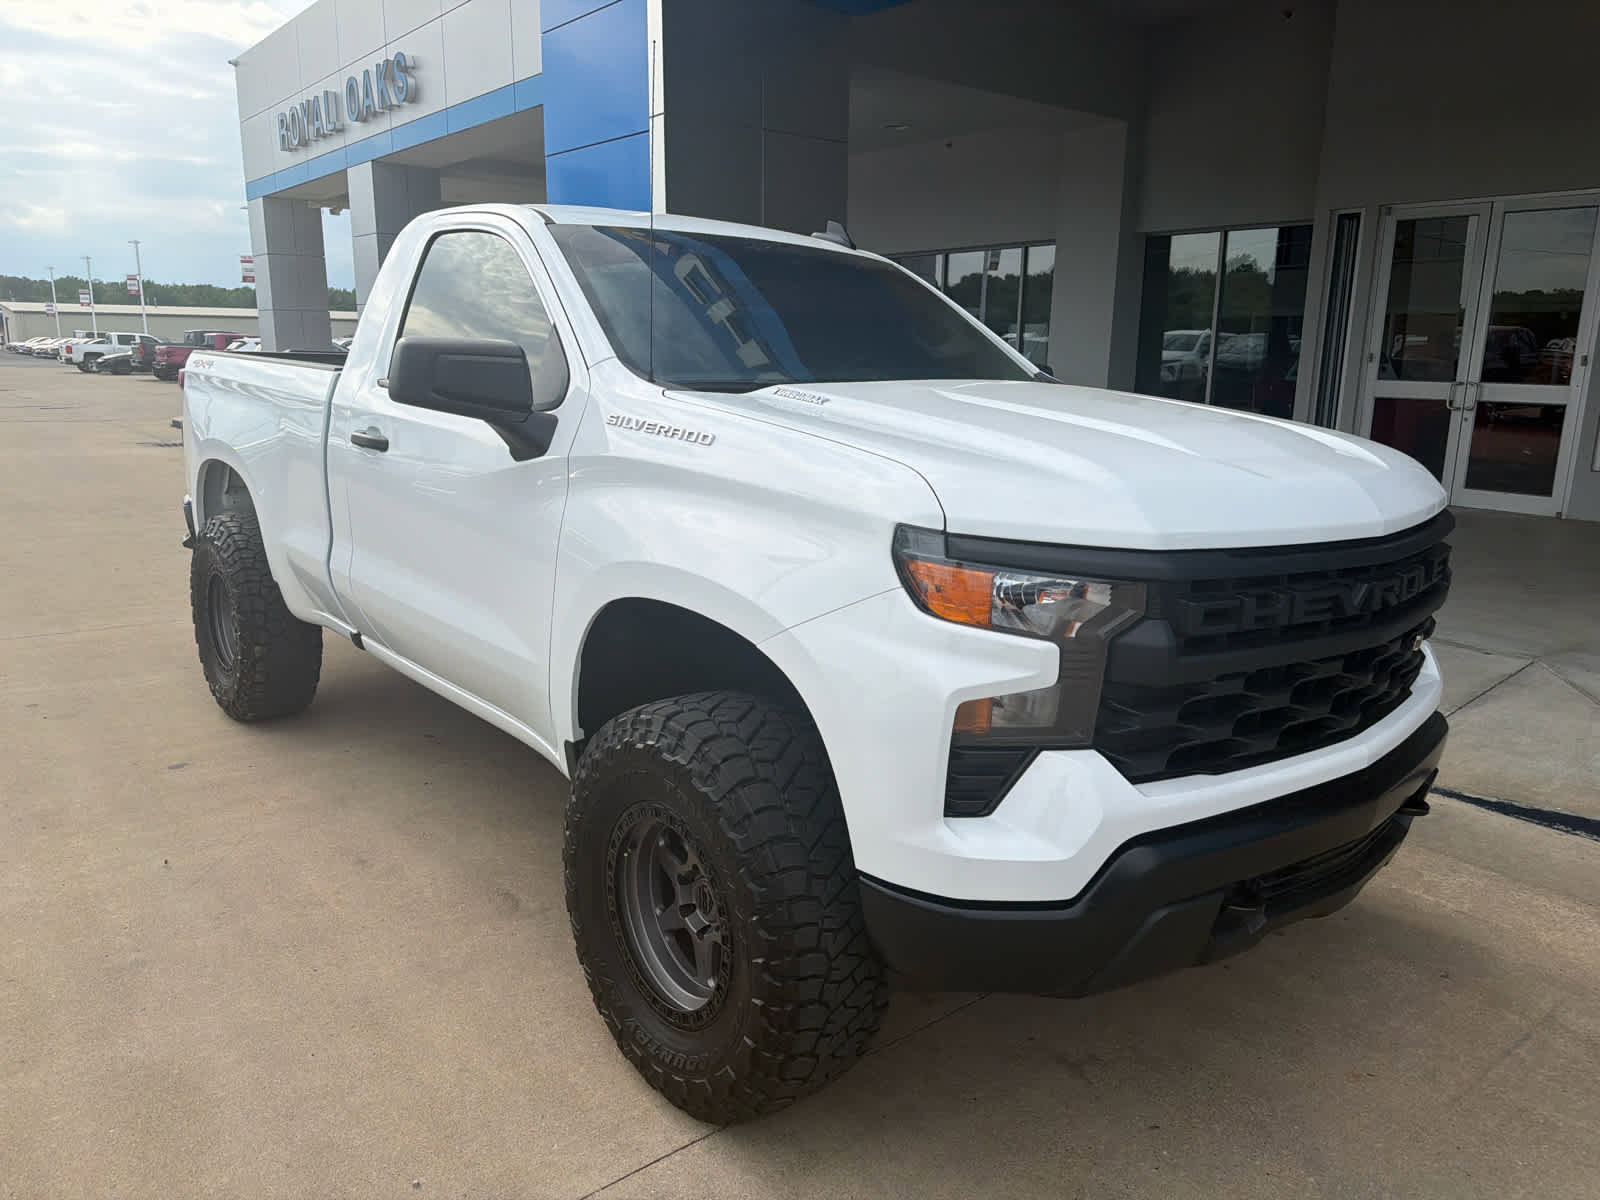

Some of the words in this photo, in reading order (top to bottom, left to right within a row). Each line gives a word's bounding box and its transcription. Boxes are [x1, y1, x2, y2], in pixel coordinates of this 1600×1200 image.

[277, 90, 339, 152] ROYAL
[345, 51, 413, 122] OAKS
[604, 415, 716, 447] SILVERADO
[1174, 555, 1449, 633] CHEVROLE
